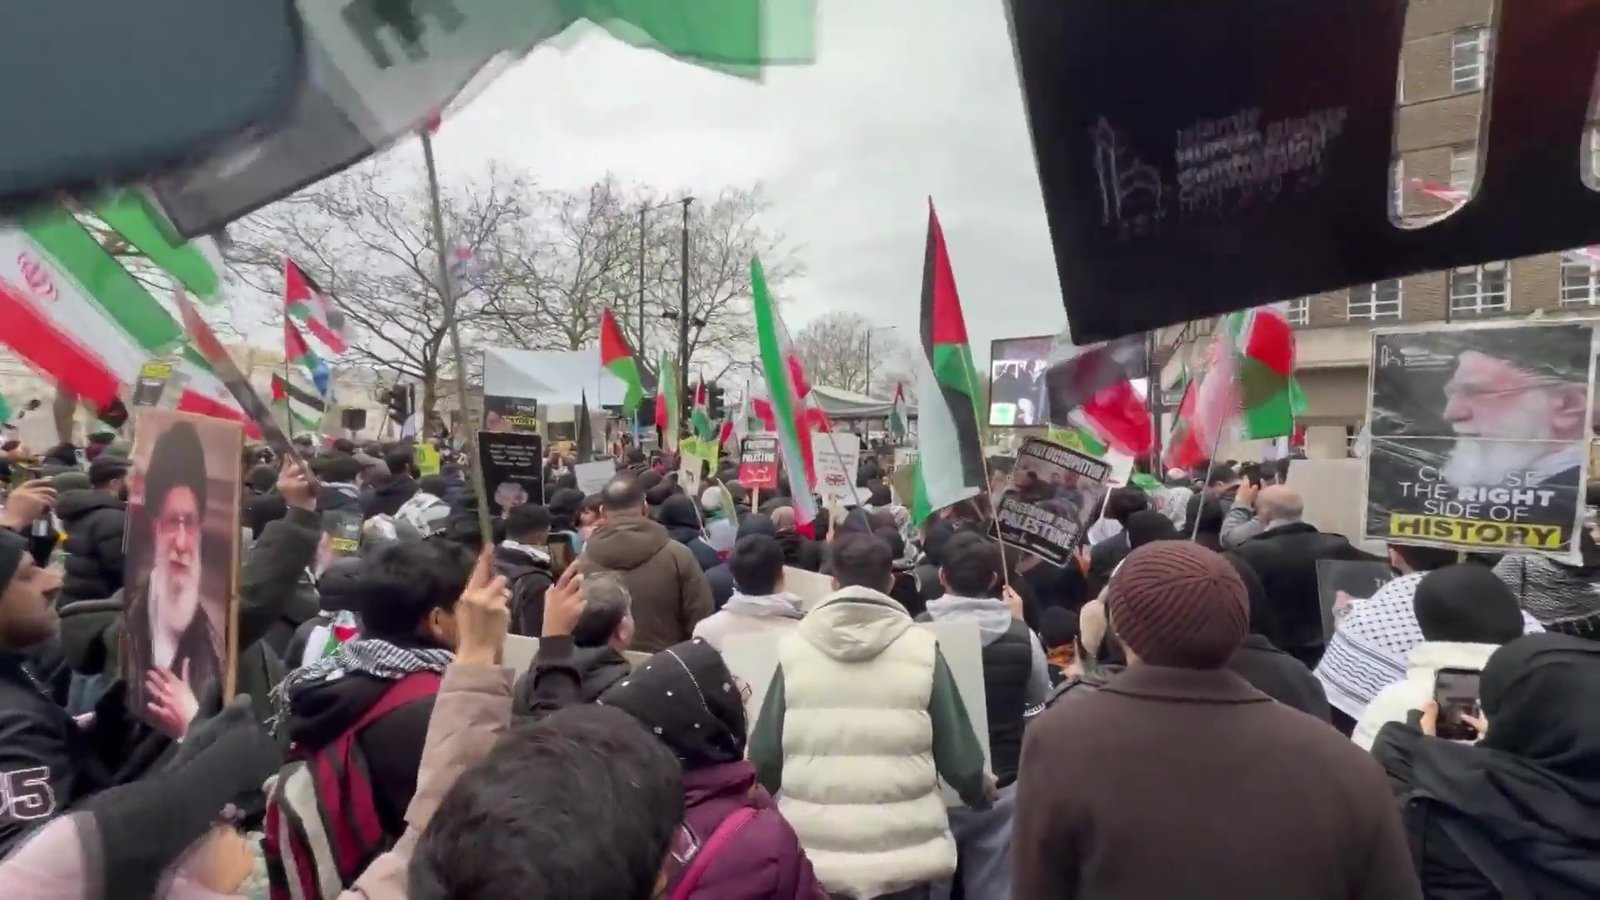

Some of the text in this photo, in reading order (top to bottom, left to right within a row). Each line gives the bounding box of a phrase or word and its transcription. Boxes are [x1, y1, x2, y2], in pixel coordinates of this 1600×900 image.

[1418, 465, 1540, 488] CSE
[1398, 481, 1556, 507] THE RIGHT
[1423, 500, 1530, 522] SIDE OF
[1397, 517, 1557, 546] HISTORY
